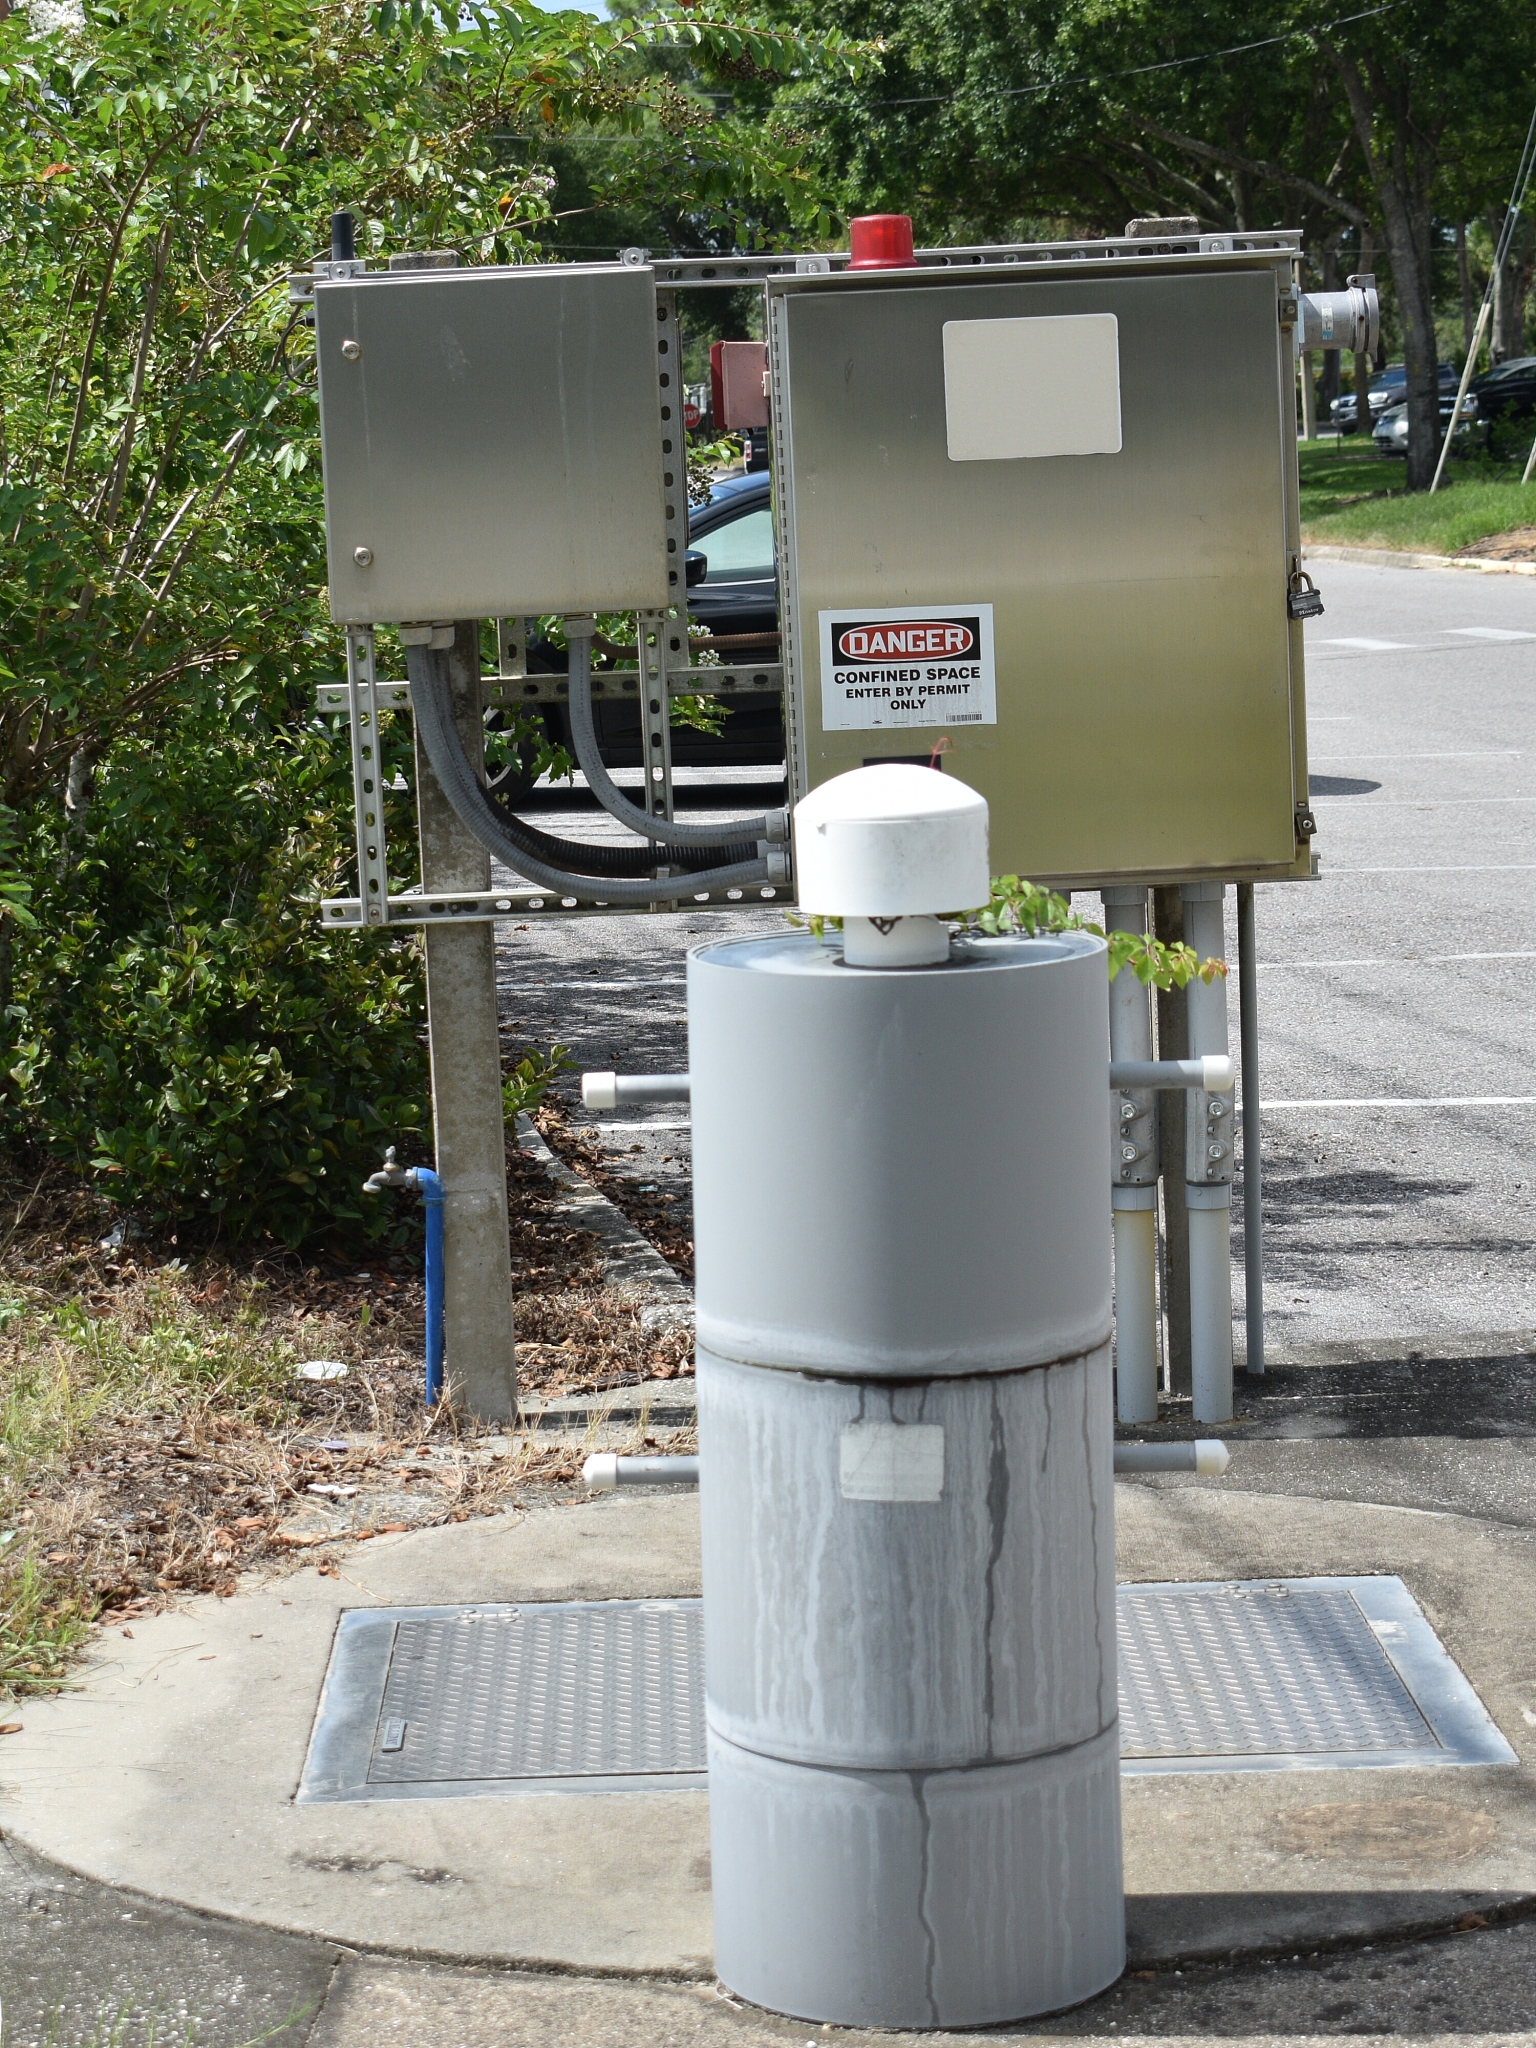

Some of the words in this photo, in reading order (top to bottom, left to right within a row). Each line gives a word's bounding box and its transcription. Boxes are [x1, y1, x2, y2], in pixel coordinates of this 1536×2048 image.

[849, 628, 963, 654] DANGER
[835, 670, 920, 684] CONFINED
[927, 667, 980, 680] SPACE
[846, 688, 890, 698] ENTER
[896, 687, 913, 696] BY
[919, 684, 970, 695] PERMIT
[891, 699, 926, 710] ONLY
